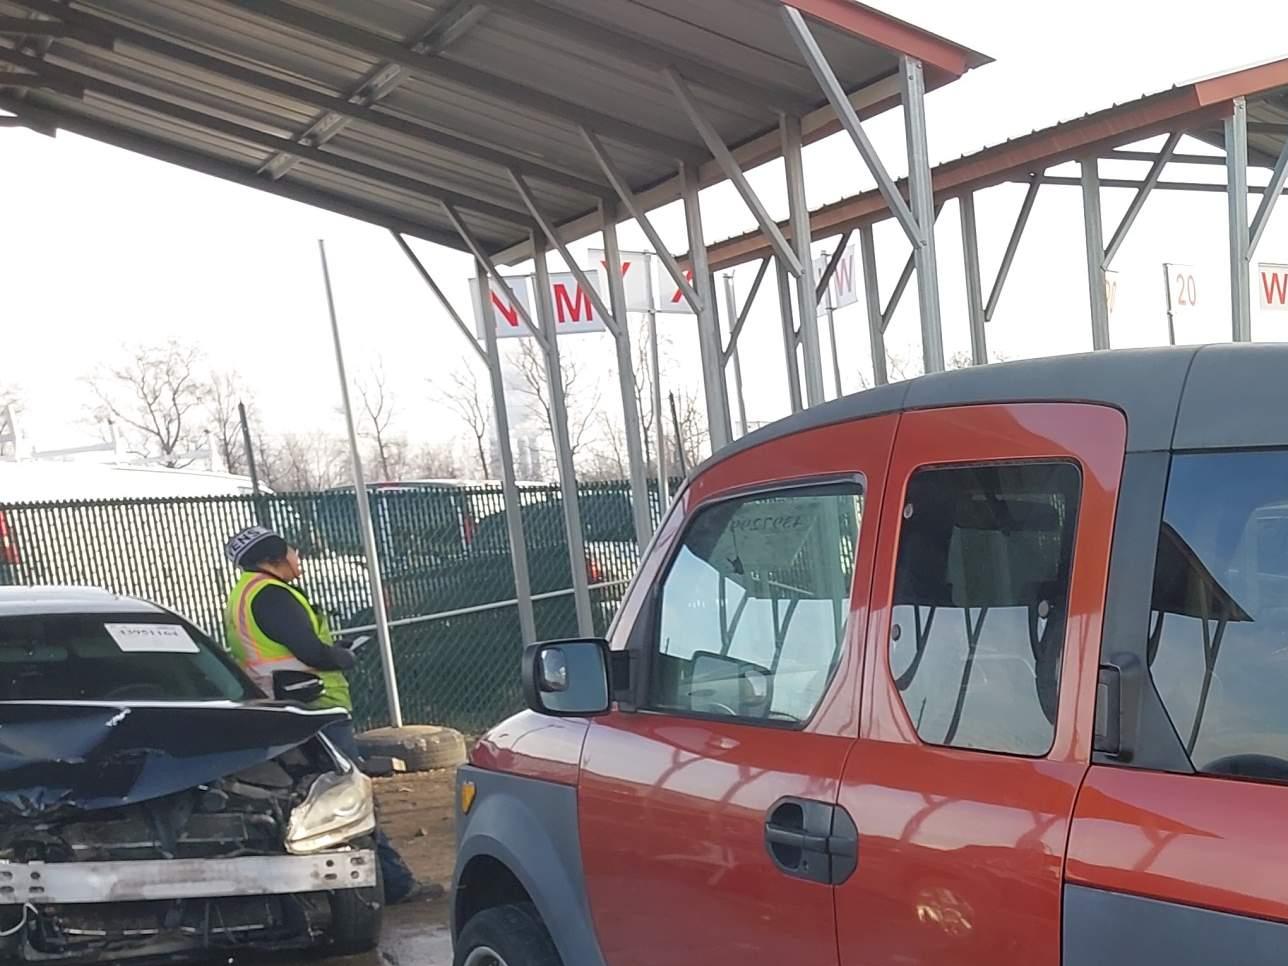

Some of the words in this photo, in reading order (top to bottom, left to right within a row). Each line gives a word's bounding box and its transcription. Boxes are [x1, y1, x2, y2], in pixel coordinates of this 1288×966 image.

[552, 283, 594, 324] M
[1176, 273, 1197, 307] 20
[1260, 271, 1288, 305] W
